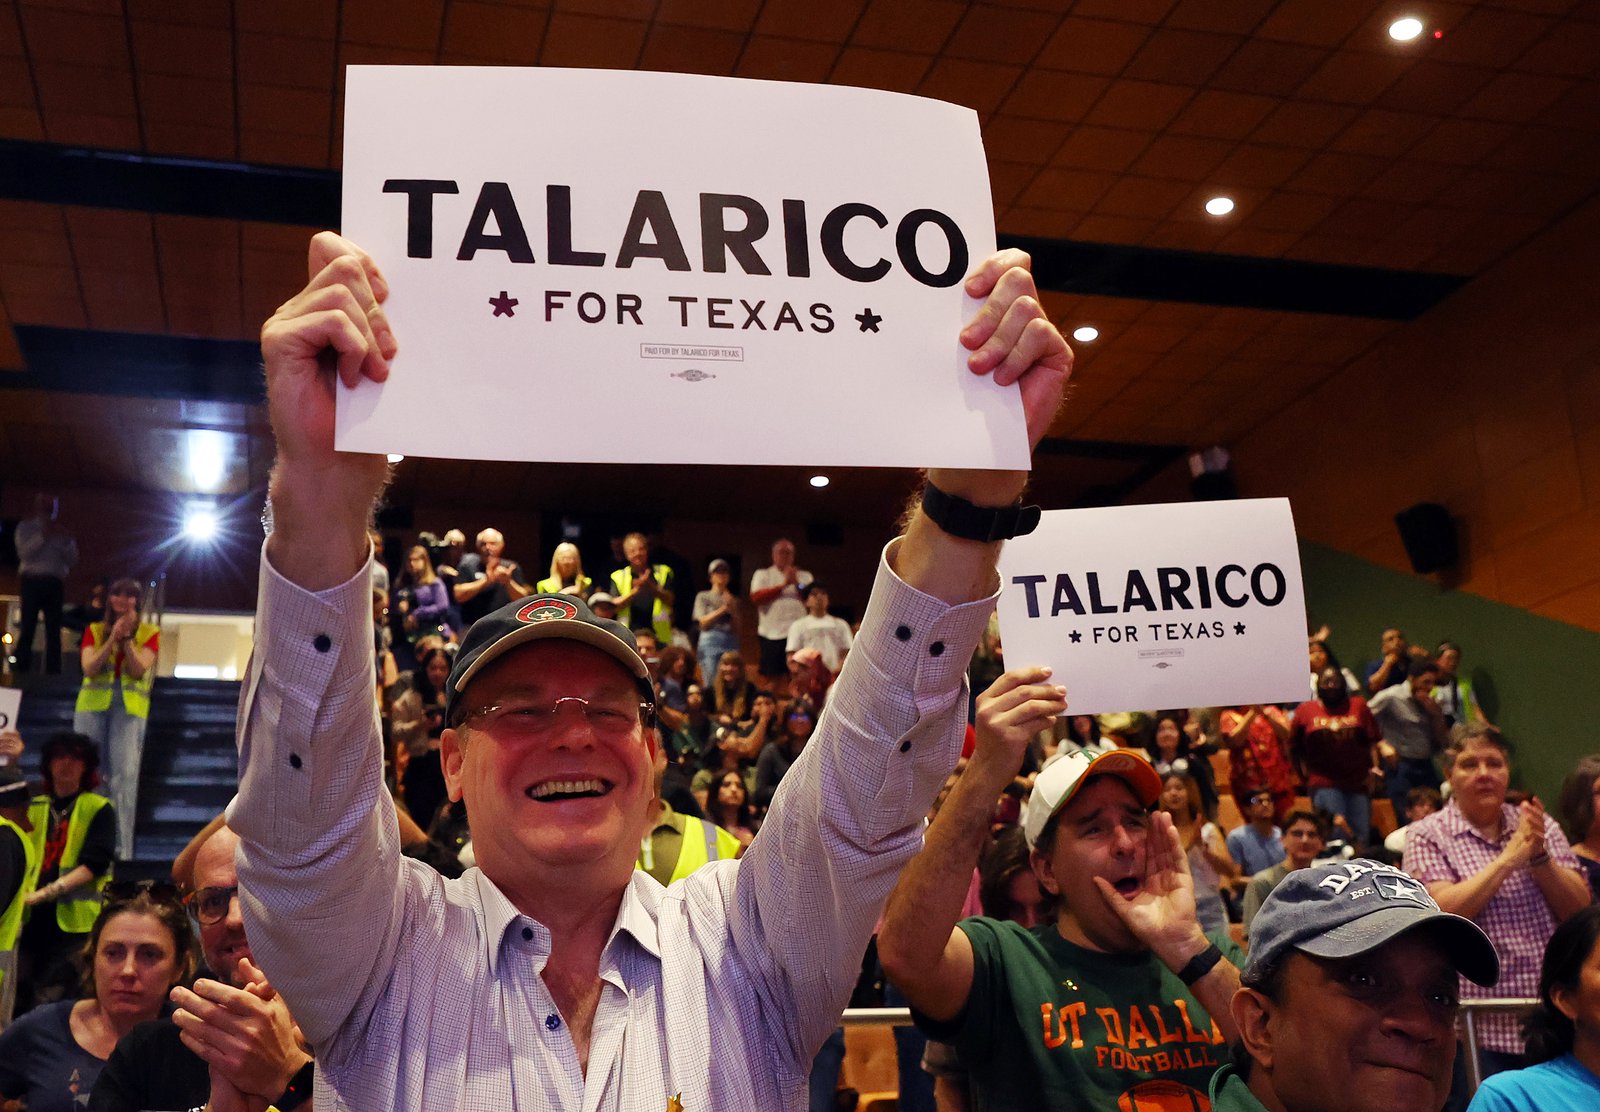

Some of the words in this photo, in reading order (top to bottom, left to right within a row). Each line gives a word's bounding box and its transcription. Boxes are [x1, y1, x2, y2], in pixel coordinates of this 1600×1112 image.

[382, 179, 970, 288] TALARICO
[545, 291, 644, 325] FOR
[669, 296, 836, 334] TEXAS
[644, 346, 658, 355] PAID
[659, 347, 671, 355] FOR
[671, 347, 679, 356] BY
[680, 348, 707, 357] TALARICO
[708, 349, 720, 357] FOR
[721, 350, 740, 358] TEXAS
[1012, 562, 1287, 618] TALARICO
[1093, 625, 1139, 644] FOR
[1148, 621, 1225, 641] TEXAS
[1350, 886, 1375, 900] EST.
[1040, 1001, 1087, 1049] UT
[1095, 1046, 1218, 1073] FOOTBALL
